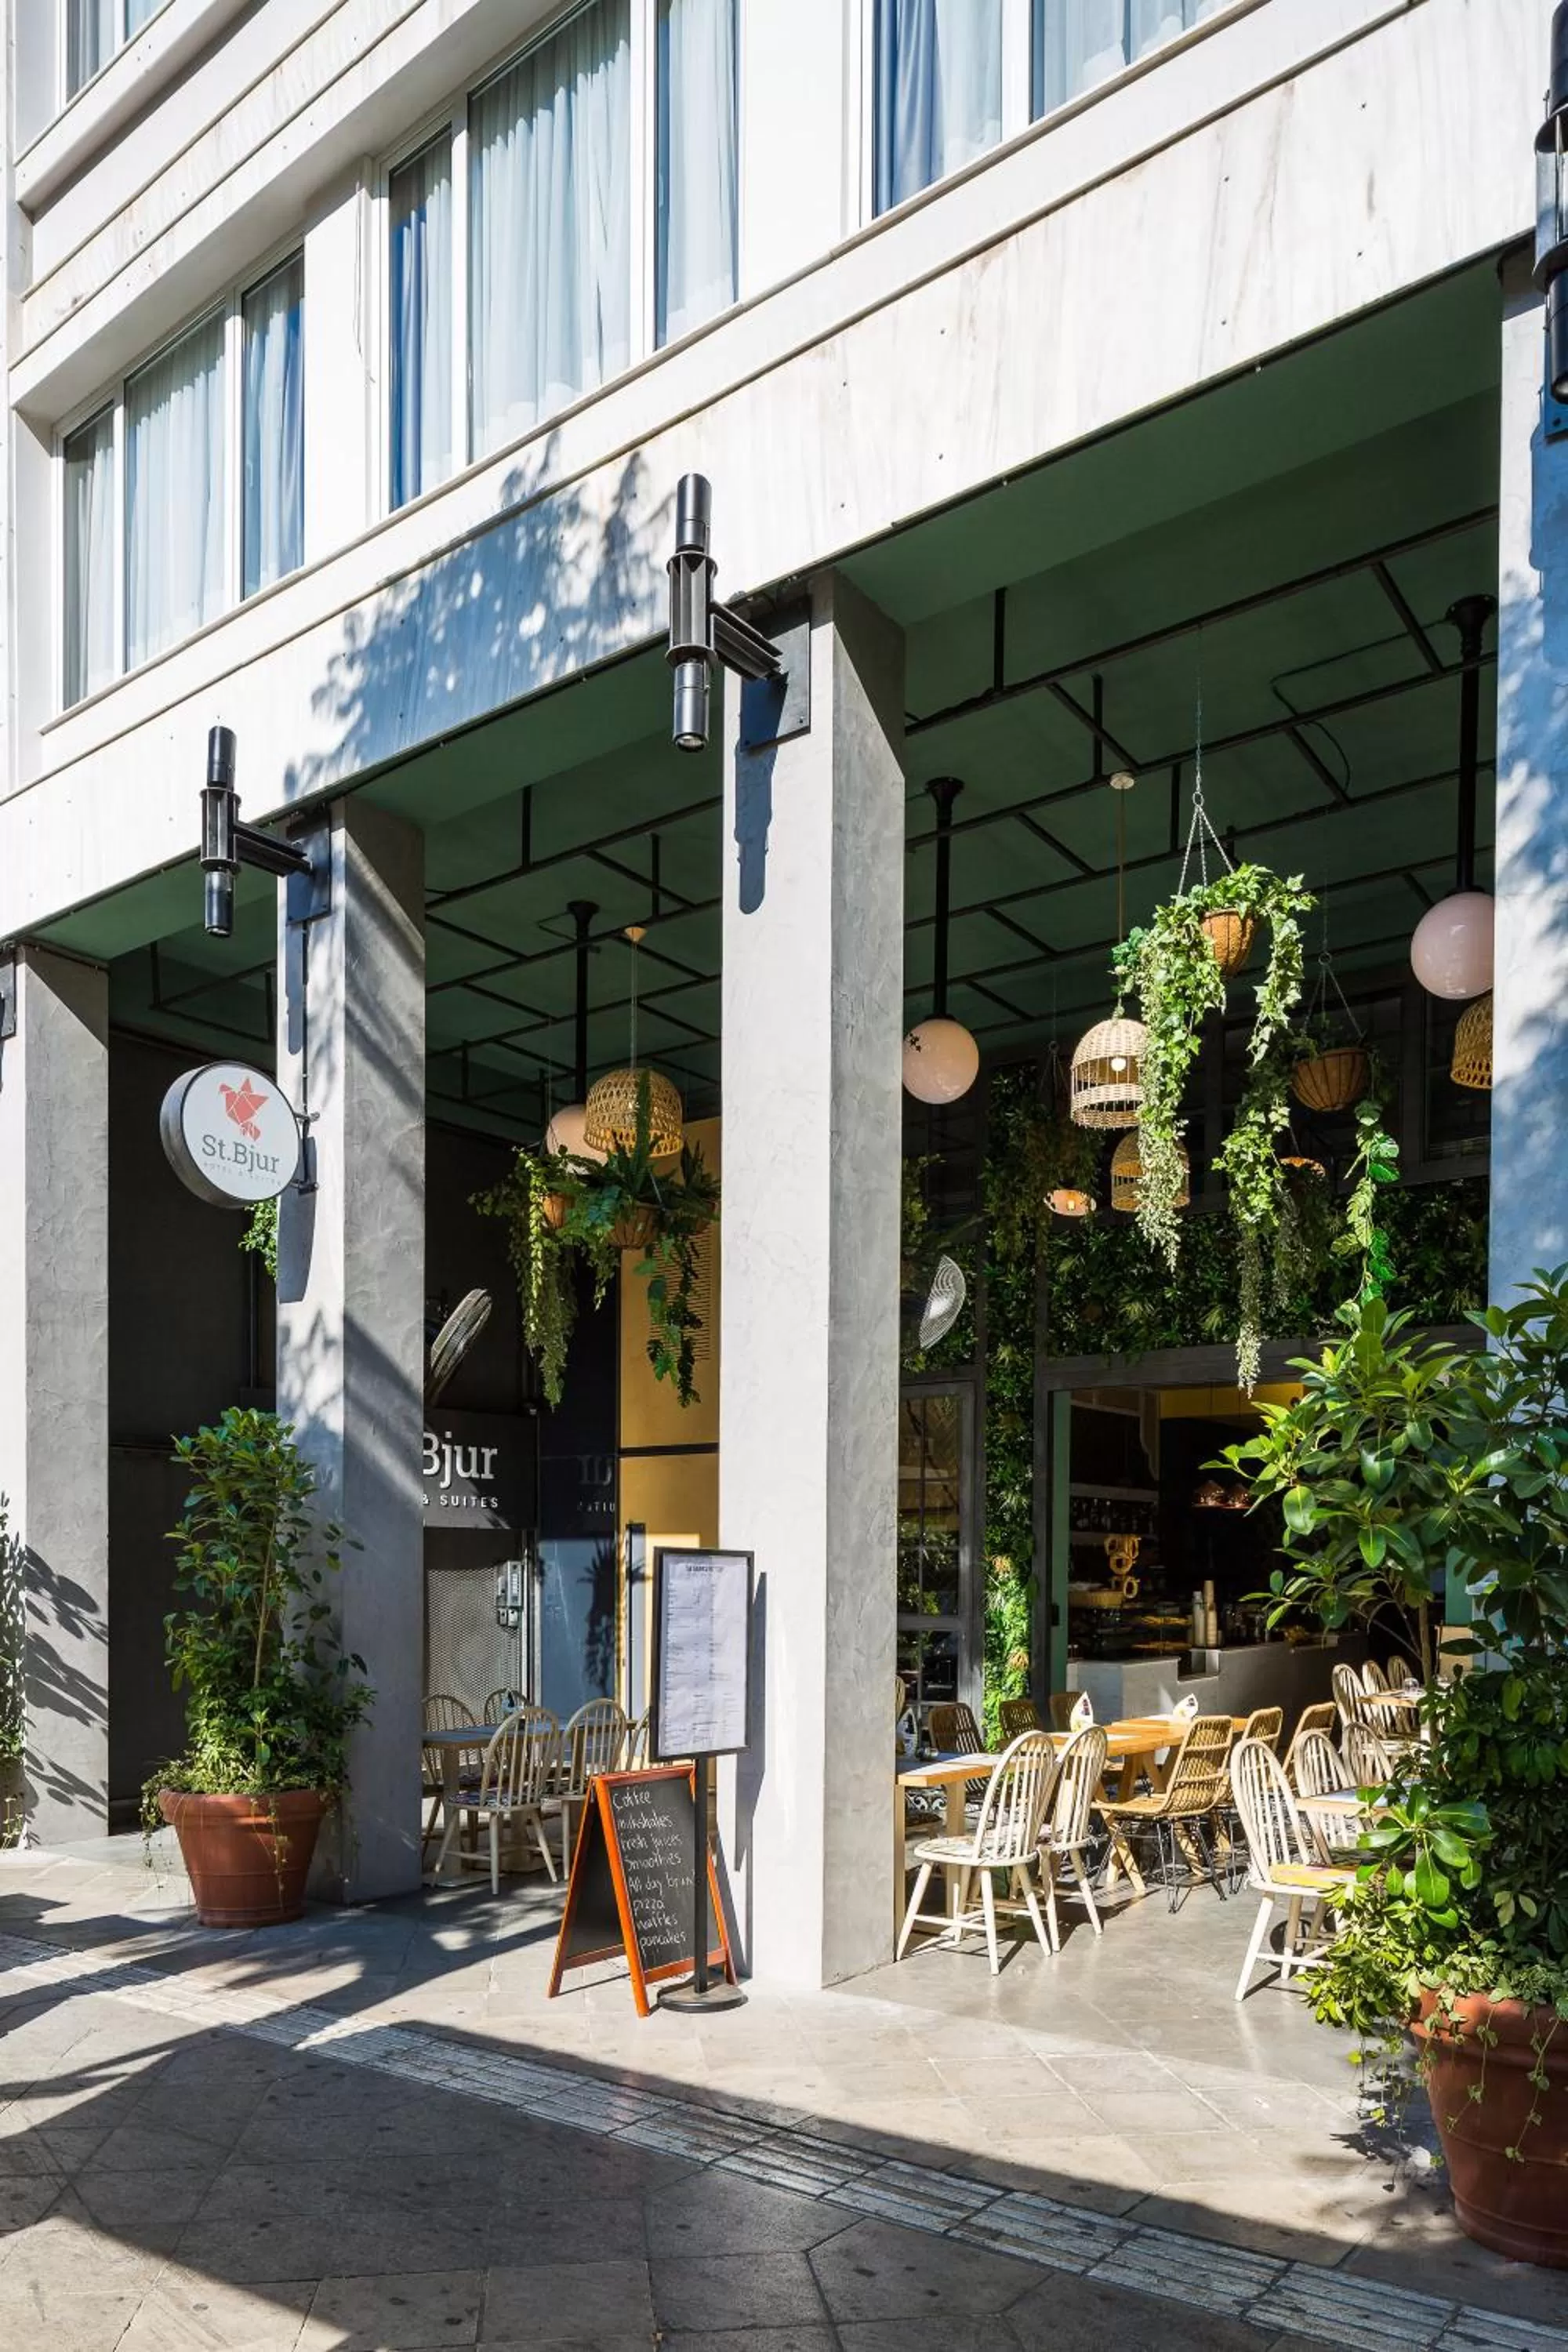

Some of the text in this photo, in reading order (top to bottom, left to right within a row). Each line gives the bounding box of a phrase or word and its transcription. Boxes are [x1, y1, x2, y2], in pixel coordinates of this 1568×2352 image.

[201, 1134, 279, 1174] St.Bjur
[440, 1494, 499, 1508] SUITES
[612, 1786, 652, 1812] Coffee
